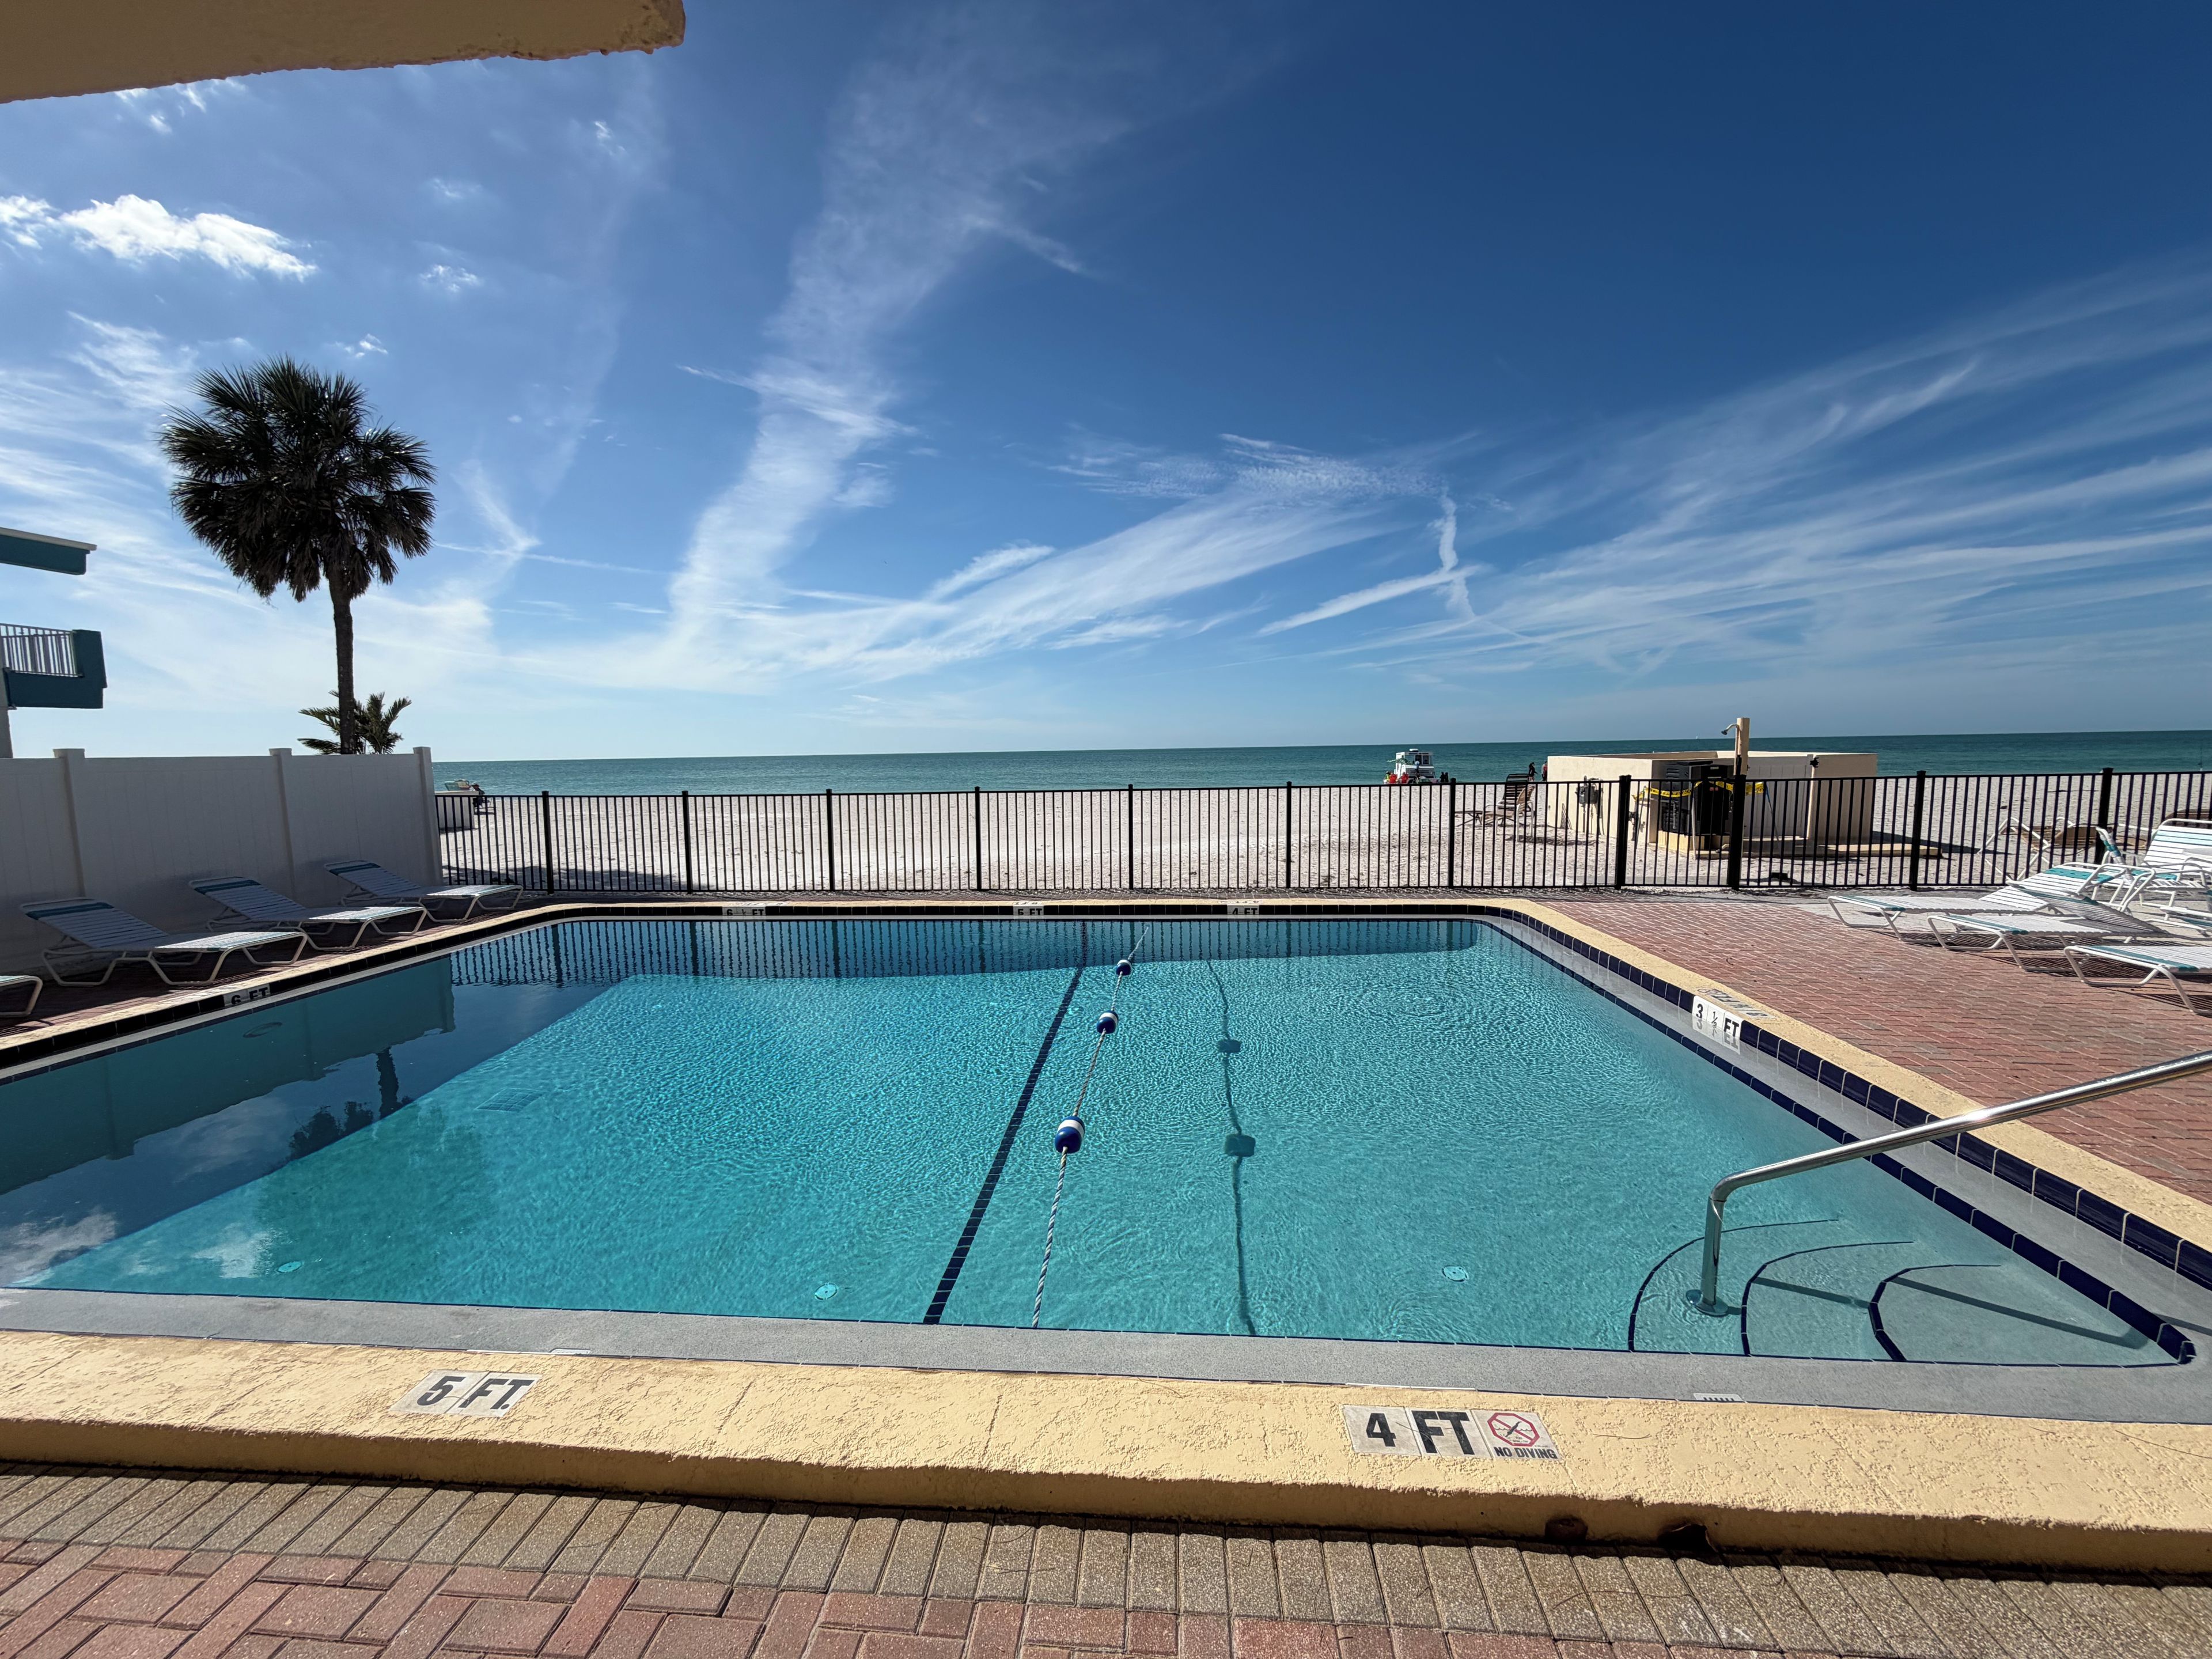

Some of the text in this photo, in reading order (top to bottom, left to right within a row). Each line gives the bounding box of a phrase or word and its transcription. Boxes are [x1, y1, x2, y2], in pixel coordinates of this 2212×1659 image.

[231, 987, 268, 1005] 6 FT
[1696, 1003, 1703, 1019] 3
[1724, 1017, 1740, 1037] FT
[416, 1376, 466, 1406] 5
[1366, 1410, 1475, 1455] 4 FT
[1493, 1446, 1558, 1459] NO DIVING
